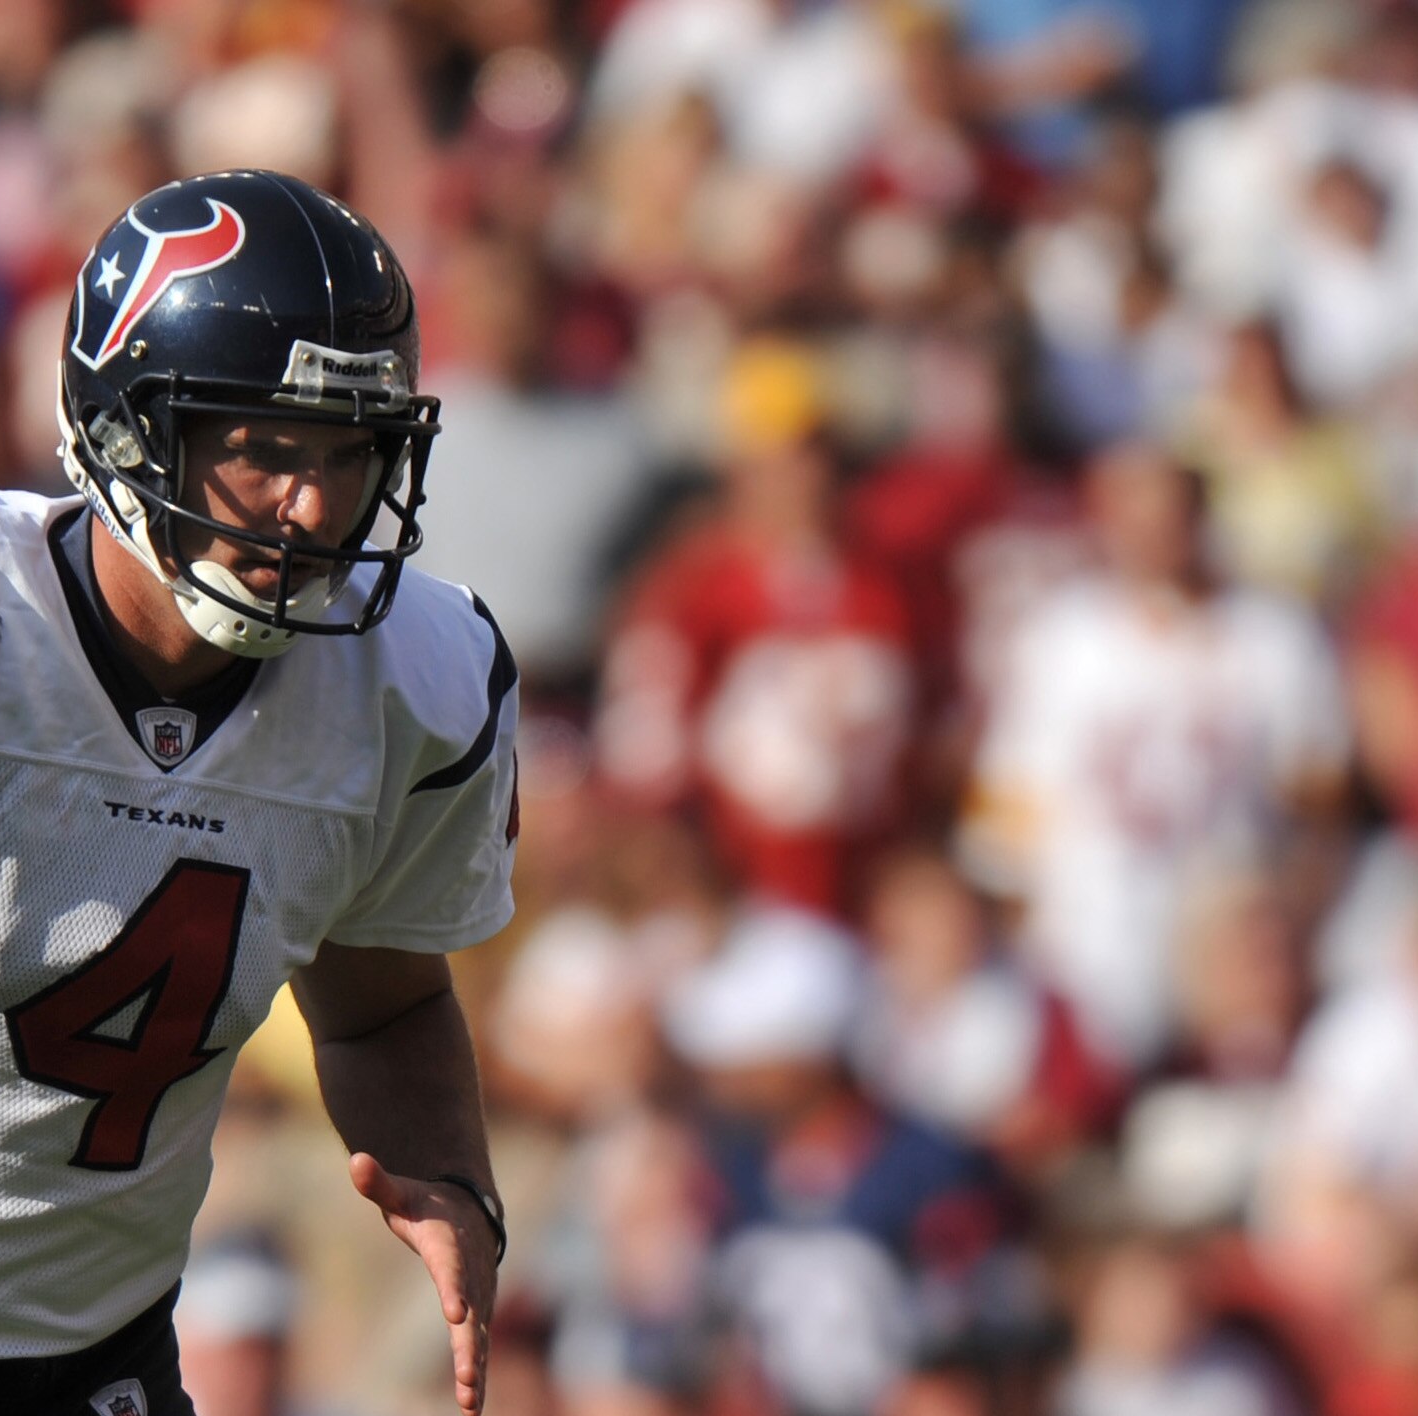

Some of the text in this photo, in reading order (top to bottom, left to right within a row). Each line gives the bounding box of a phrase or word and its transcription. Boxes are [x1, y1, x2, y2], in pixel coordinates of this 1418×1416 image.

[322, 358, 378, 377] Riddell
[156, 736, 181, 754] NFL
[103, 801, 226, 833] TEXANS
[6, 858, 251, 1171] 4
